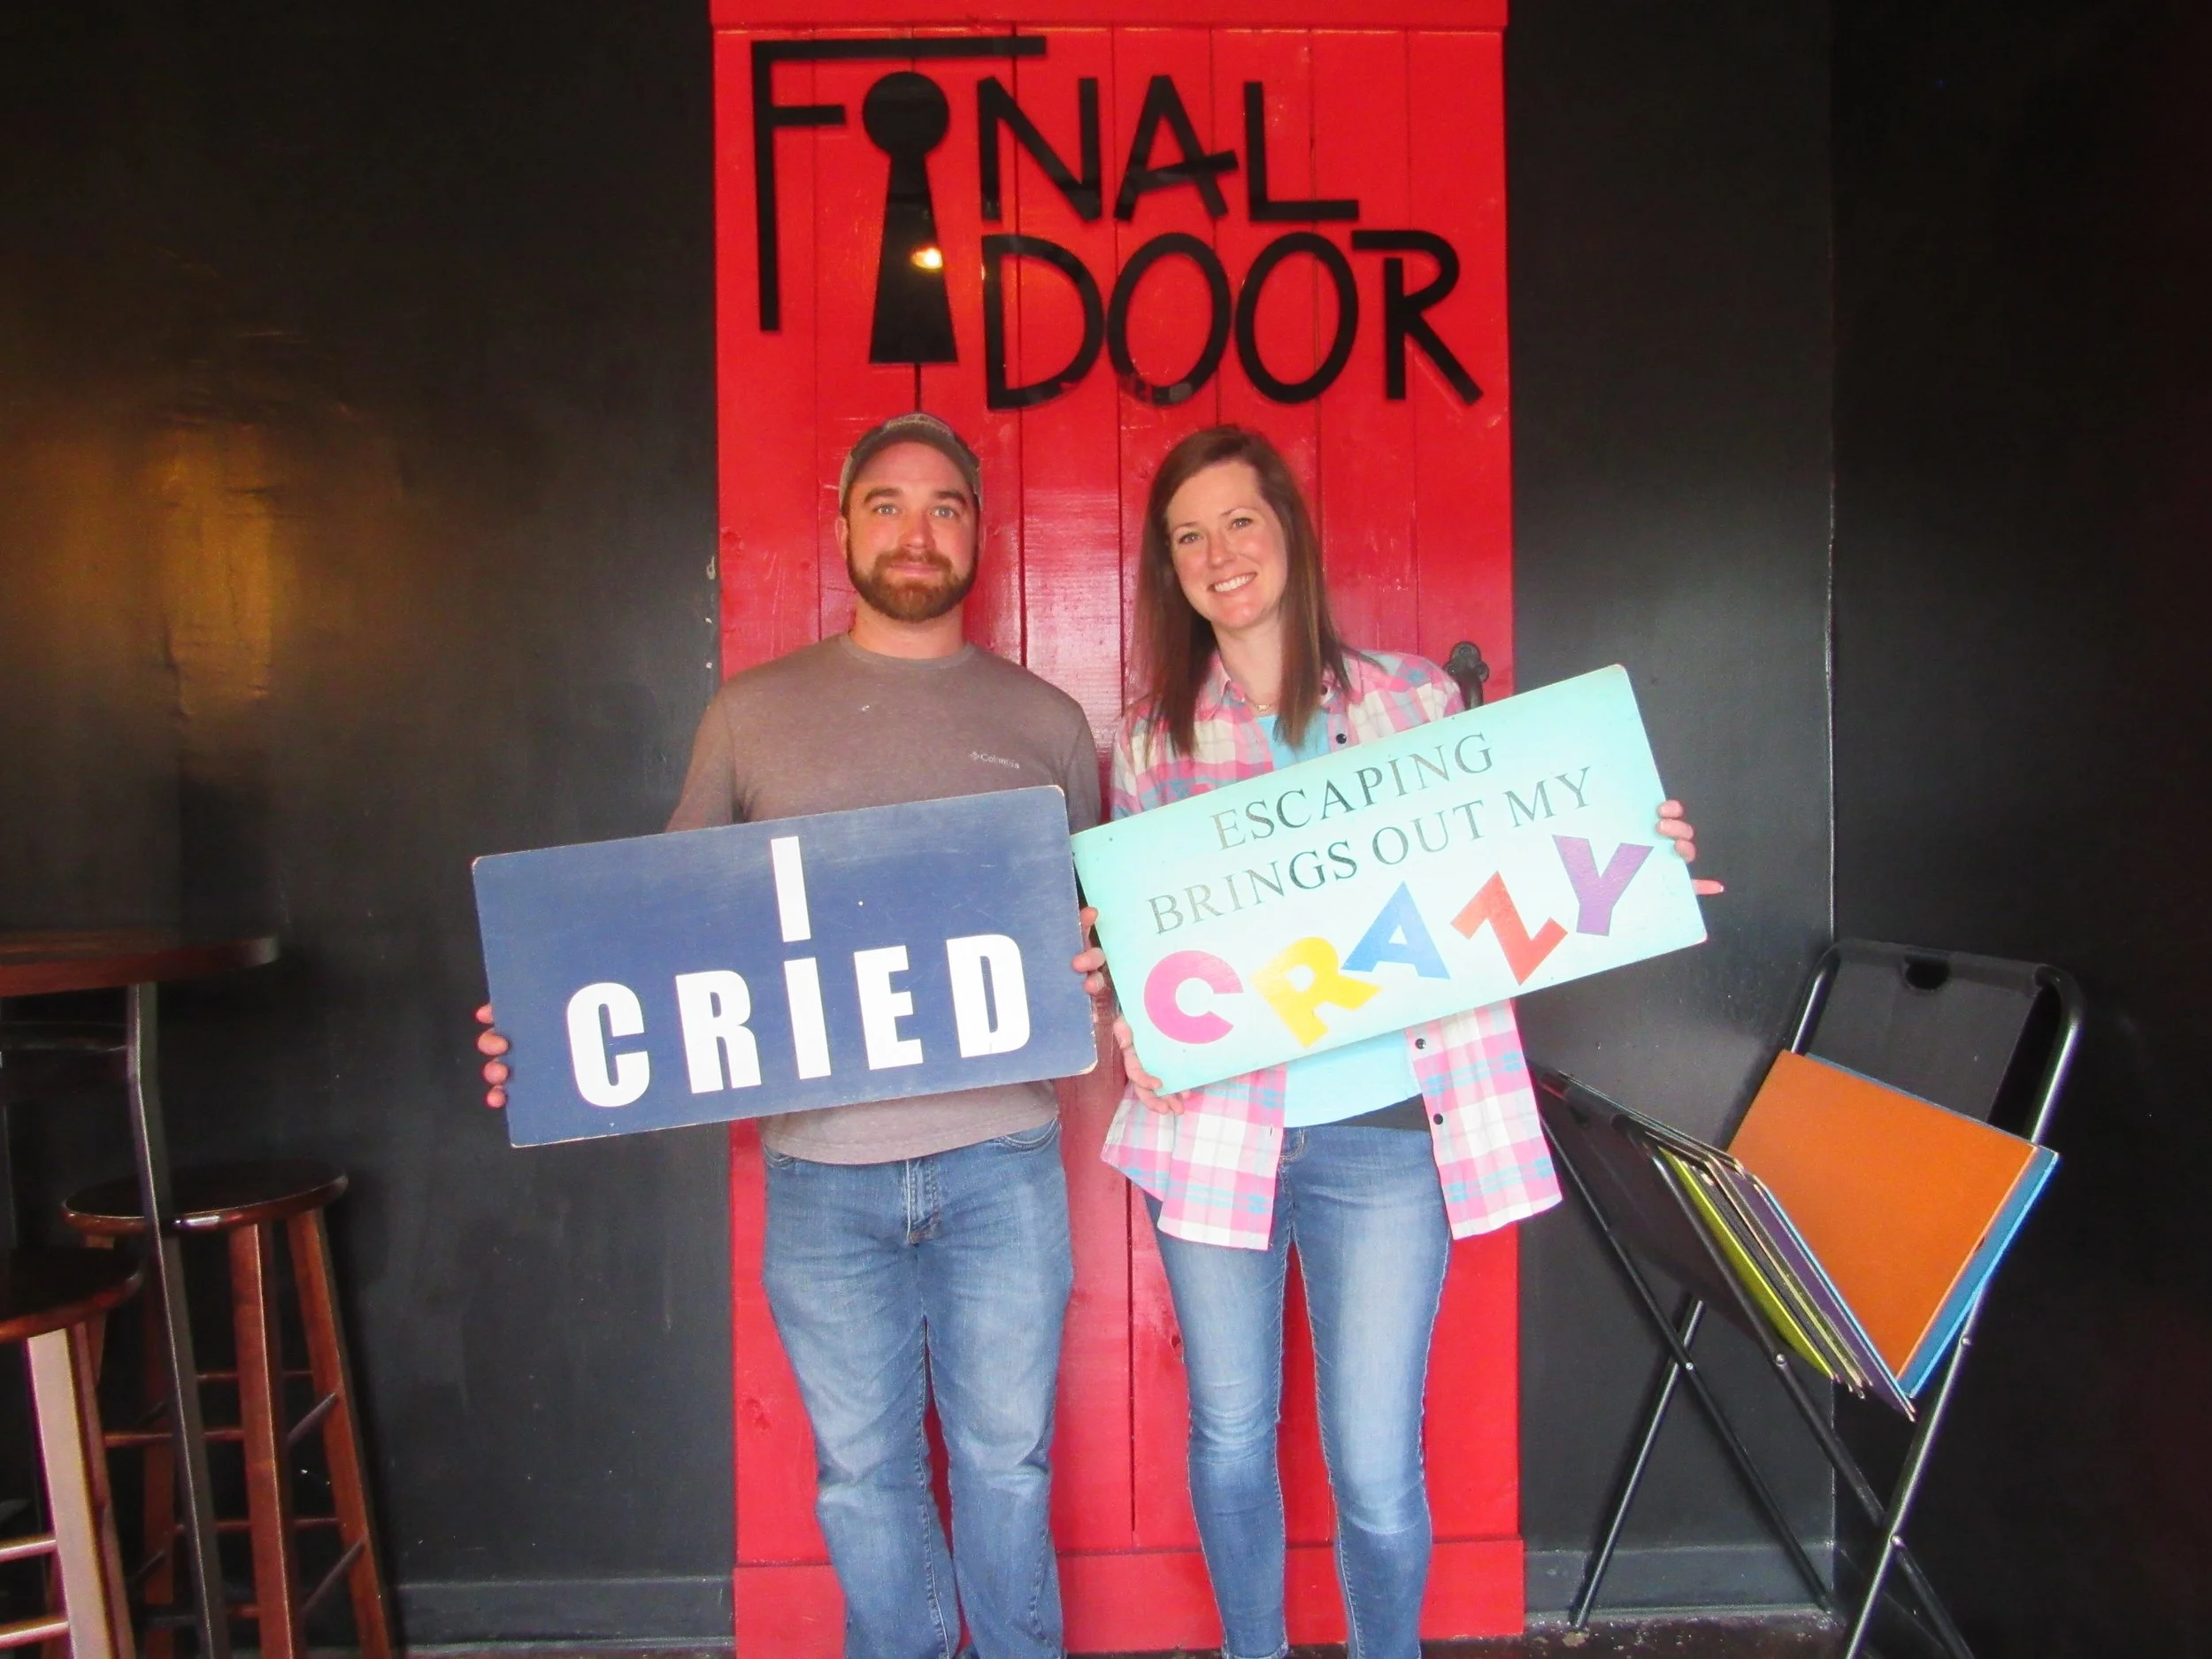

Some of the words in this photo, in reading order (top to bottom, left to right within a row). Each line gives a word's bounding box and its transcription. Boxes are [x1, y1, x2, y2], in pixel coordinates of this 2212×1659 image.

[750, 36, 1360, 365] FINAL
[980, 230, 1486, 411] DOOR
[1148, 841, 1358, 935] BRINGS
[1371, 801, 1486, 868] OUT
[1502, 766, 1593, 829] MY
[1210, 732, 1494, 851] ESCAPING
[771, 836, 811, 942] I
[1143, 834, 1655, 1048] CRAZY
[566, 934, 1030, 1107] CRIED
